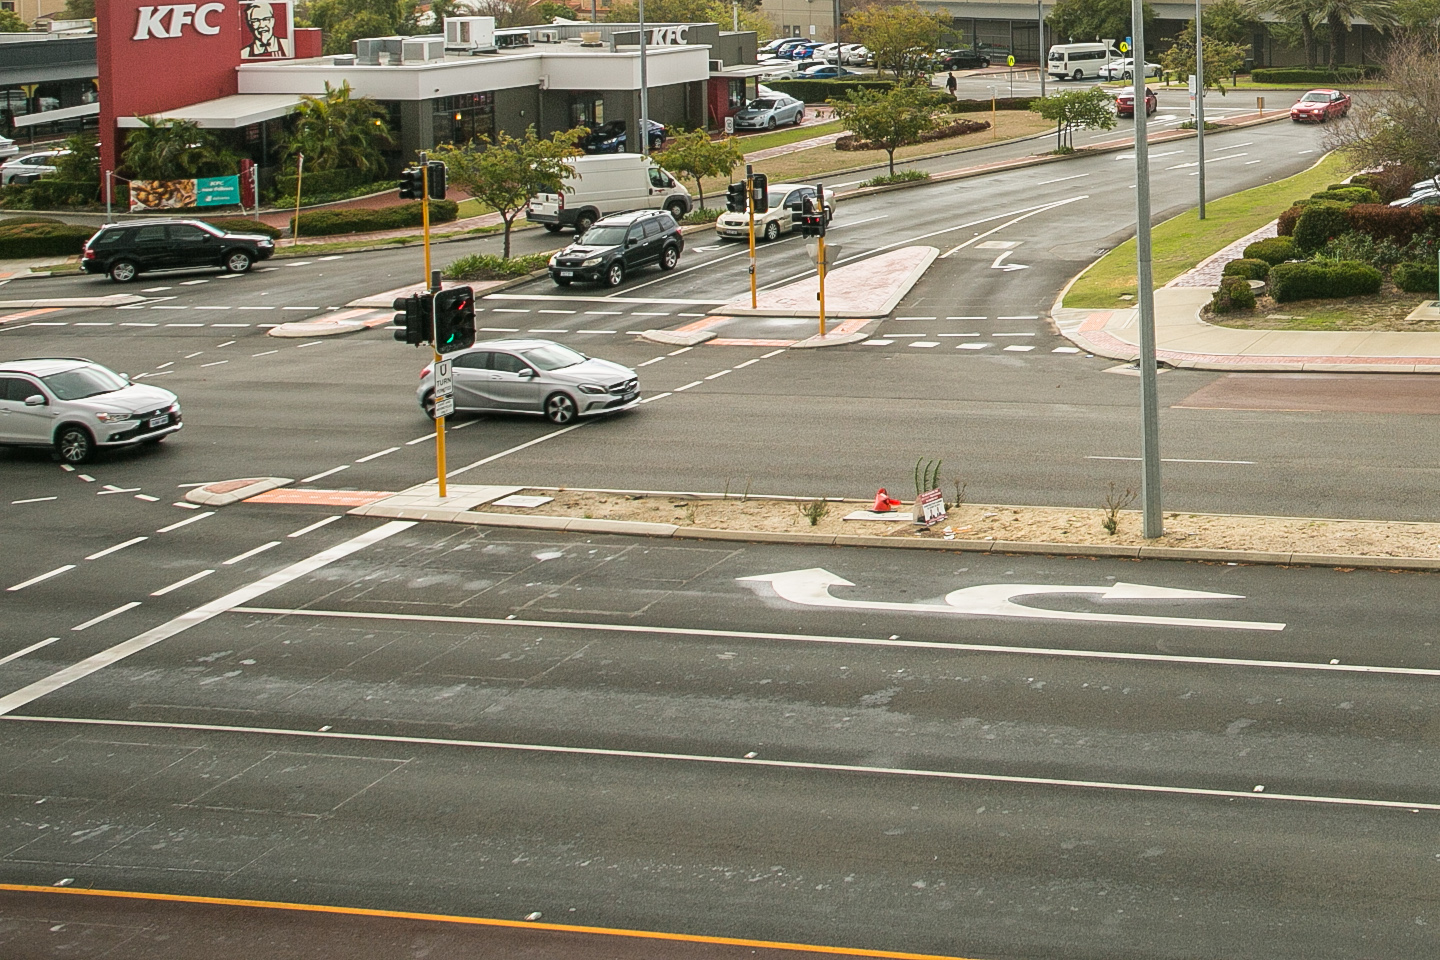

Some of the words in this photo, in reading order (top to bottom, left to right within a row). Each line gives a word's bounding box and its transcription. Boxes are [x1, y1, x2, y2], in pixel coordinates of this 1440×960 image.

[133, 2, 225, 40] KFC
[651, 24, 690, 46] KFC
[440, 364, 447, 376] U
[437, 377, 452, 387] TURN
